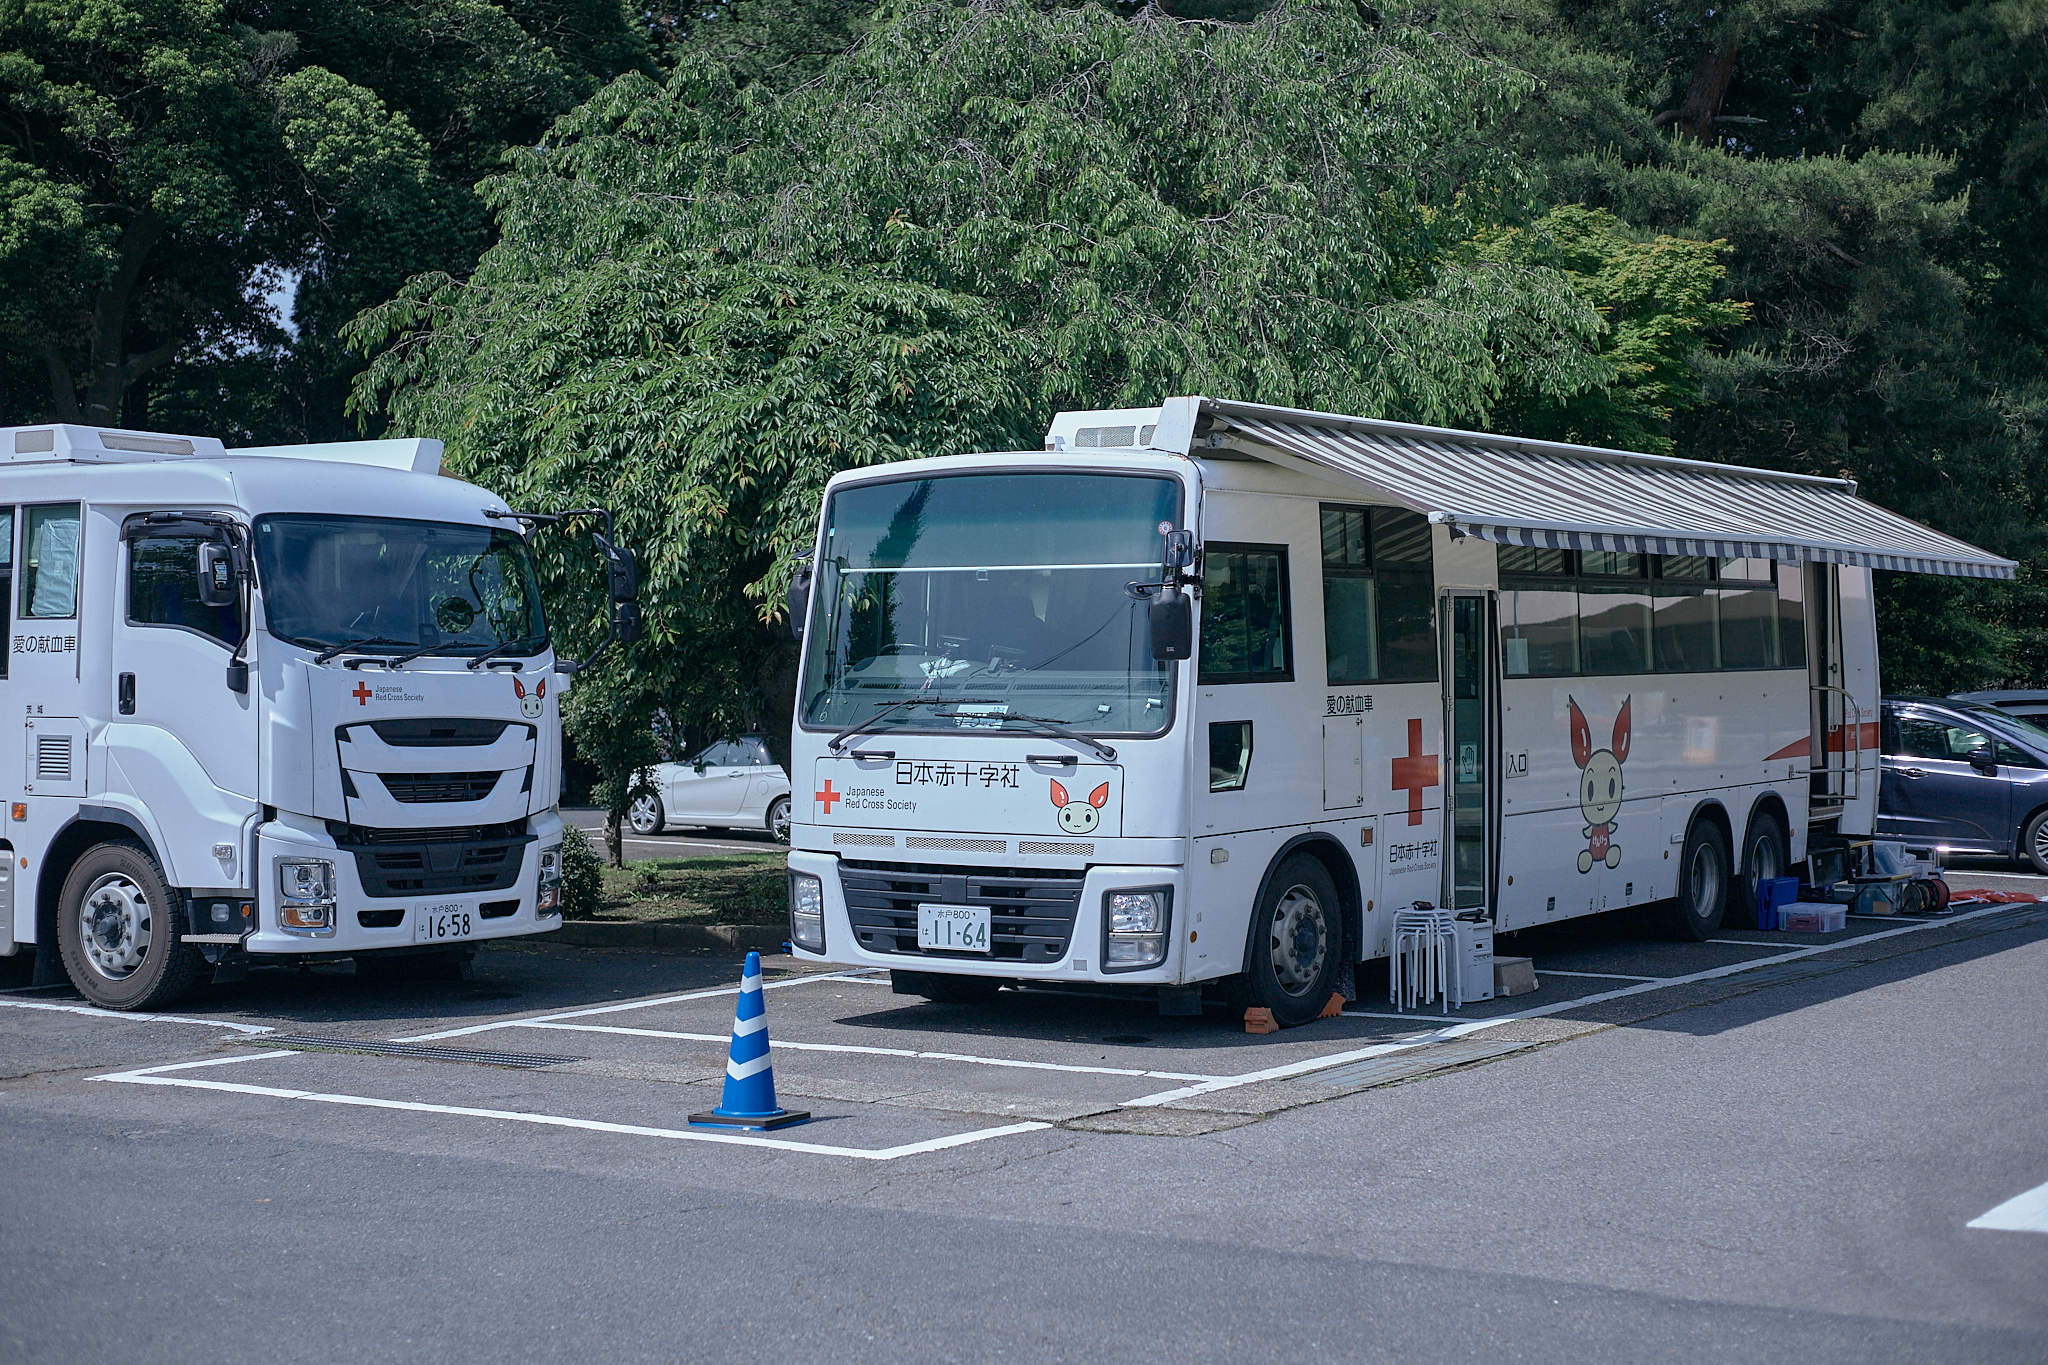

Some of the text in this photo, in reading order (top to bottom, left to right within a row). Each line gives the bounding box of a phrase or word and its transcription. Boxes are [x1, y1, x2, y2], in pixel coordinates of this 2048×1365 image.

[13, 635, 76, 653] 愛の献血車
[376, 685, 403, 694] Japanese
[376, 693, 424, 702] Red Cross Society
[1327, 694, 1373, 714] 愛の献血車
[1509, 754, 1527, 772] 入口
[896, 762, 1020, 788] 日本赤十字社
[846, 786, 885, 798] Japanese
[845, 798, 917, 813] Red Cross Society
[1390, 839, 1437, 862] 日本赤十字社
